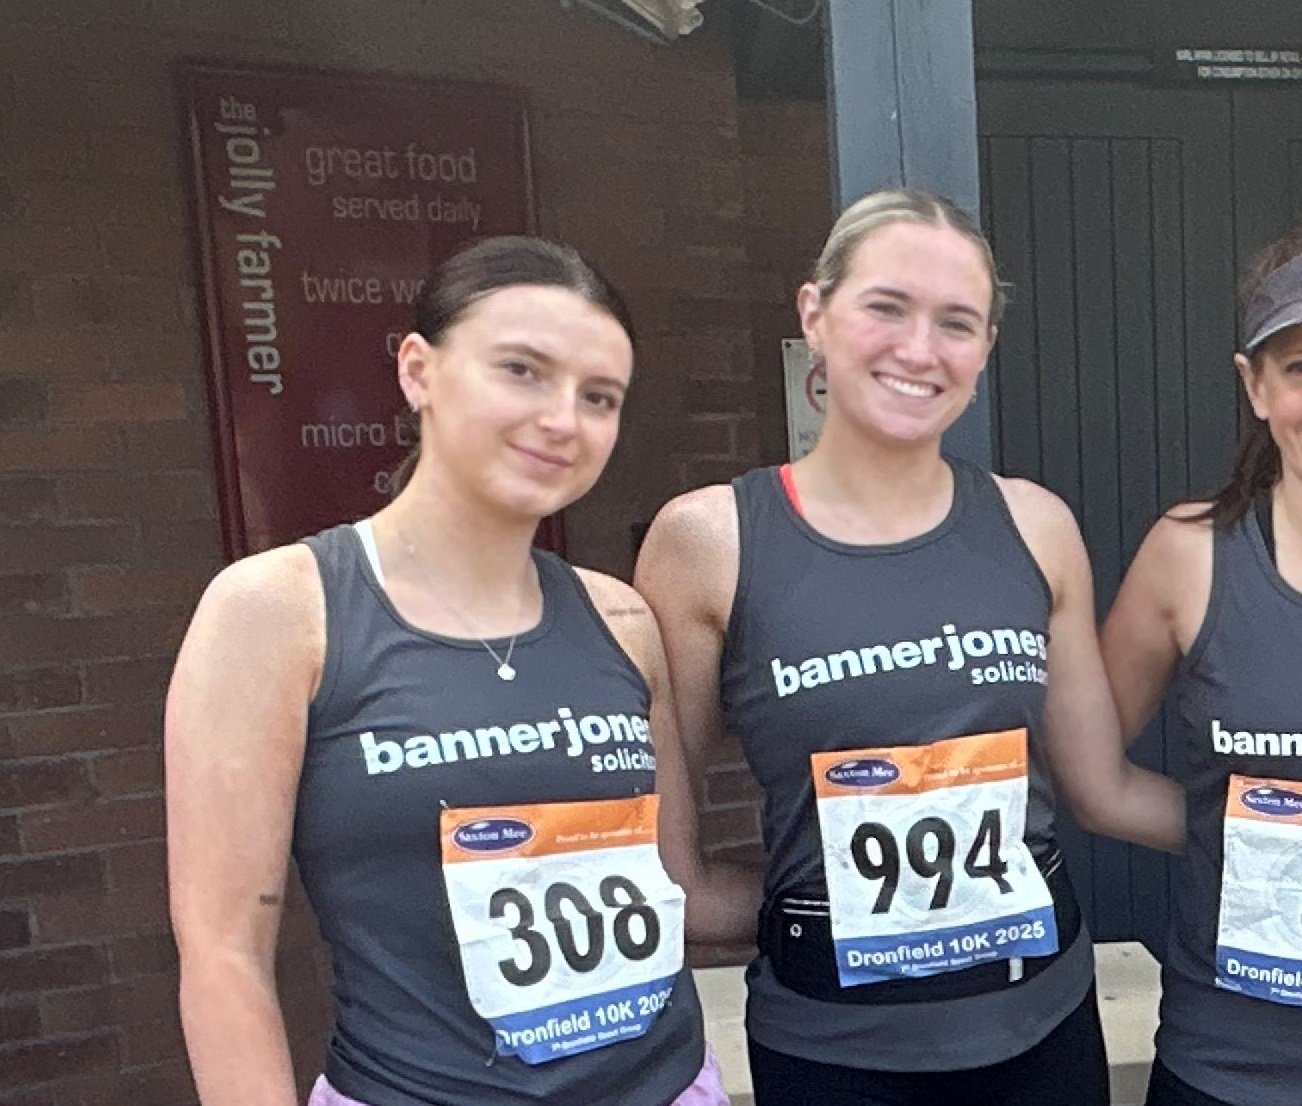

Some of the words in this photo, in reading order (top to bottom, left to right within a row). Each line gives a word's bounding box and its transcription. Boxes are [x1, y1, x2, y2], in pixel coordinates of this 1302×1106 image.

[220, 96, 256, 120] the
[213, 121, 276, 218] jolly
[305, 145, 400, 186] great
[404, 143, 477, 183] food
[332, 194, 419, 221] served
[427, 194, 482, 232] daily
[303, 270, 382, 305] twice
[235, 229, 284, 395] farmer
[301, 415, 386, 448] micro
[359, 707, 654, 775] bannerjone
[850, 807, 1014, 915] 994
[489, 875, 661, 987] 308
[847, 940, 945, 967] Dronfield
[949, 932, 991, 953] 10K
[995, 920, 1046, 945] 2025
[595, 1000, 635, 1026] 10K
